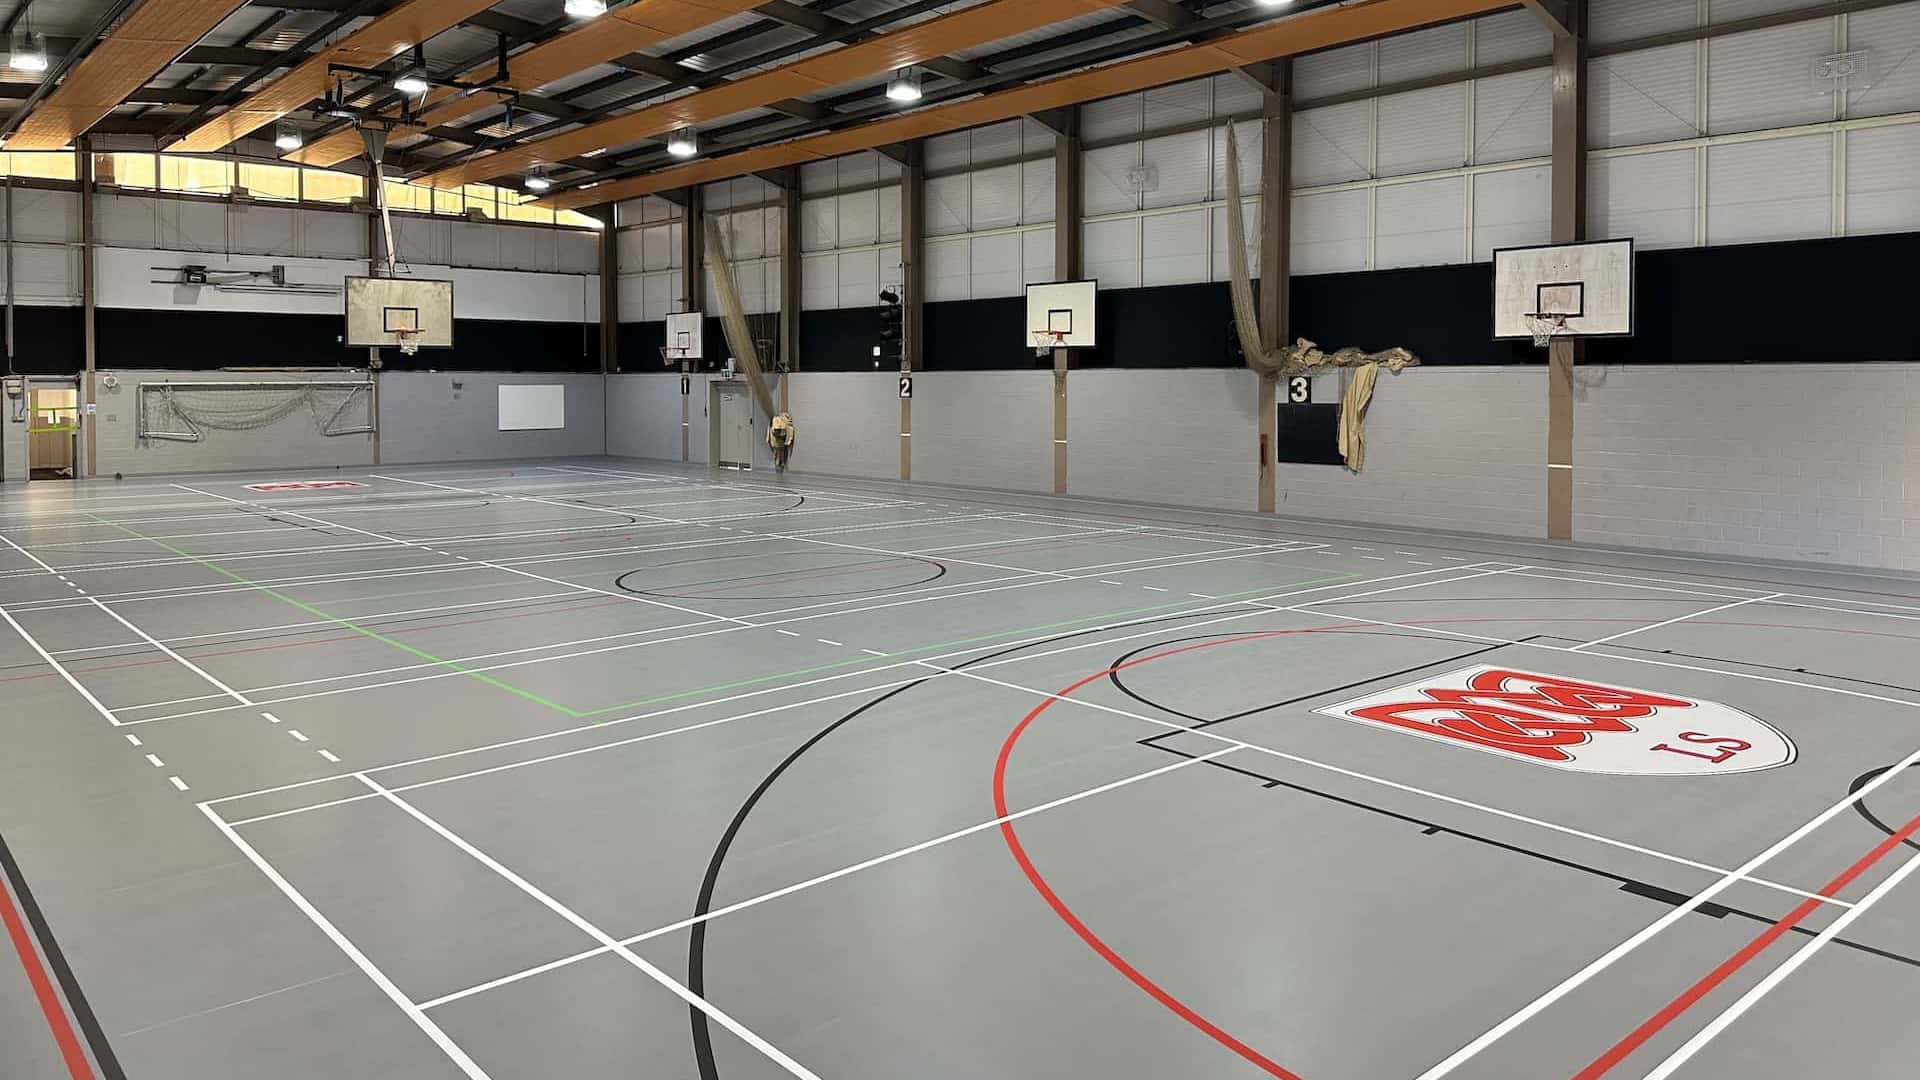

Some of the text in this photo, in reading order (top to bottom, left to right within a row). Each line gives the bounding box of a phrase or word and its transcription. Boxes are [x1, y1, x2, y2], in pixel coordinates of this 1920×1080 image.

[901, 378, 910, 397] 2
[1291, 376, 1308, 403] 3
[1649, 731, 1752, 763] LS
